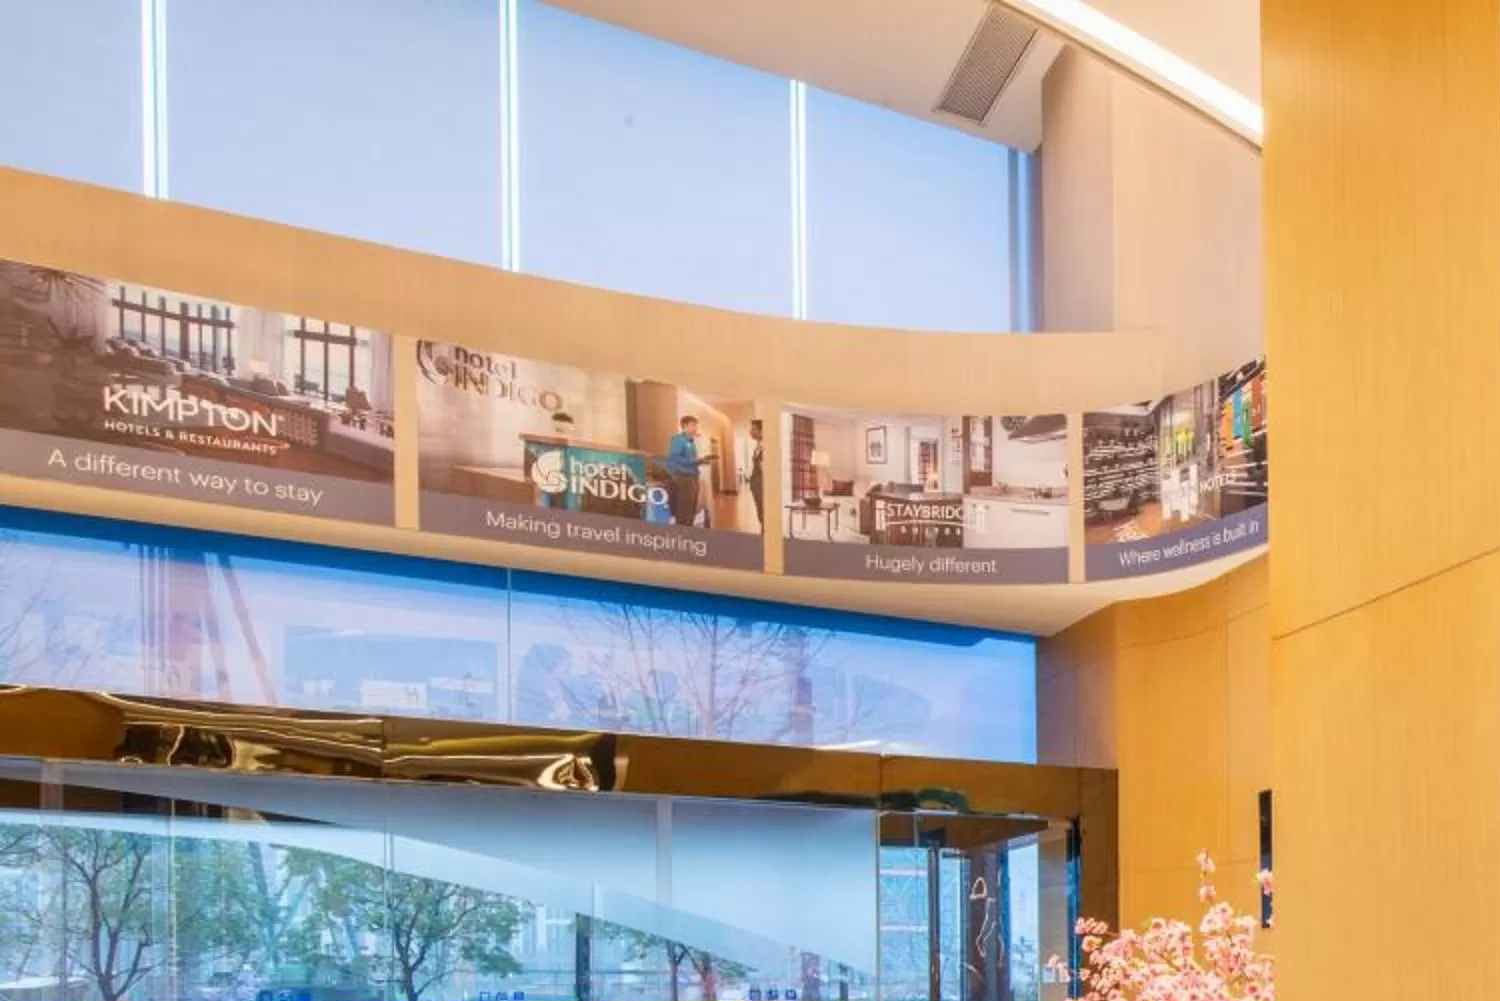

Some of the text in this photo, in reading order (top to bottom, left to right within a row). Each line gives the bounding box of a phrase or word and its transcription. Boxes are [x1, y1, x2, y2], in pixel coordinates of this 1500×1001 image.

[103, 385, 278, 437] KIMPTON
[104, 420, 160, 438] HOTELS
[179, 431, 278, 456] RESTAURANTS
[48, 449, 324, 507] A different way to stay
[570, 457, 629, 482] hotel
[570, 479, 668, 505] INDIGO
[486, 511, 708, 557] Making travel inspiring
[1118, 549, 1161, 568] Where
[1212, 532, 1221, 546] is
[1249, 519, 1259, 535] in
[865, 553, 997, 574] Hugely different
